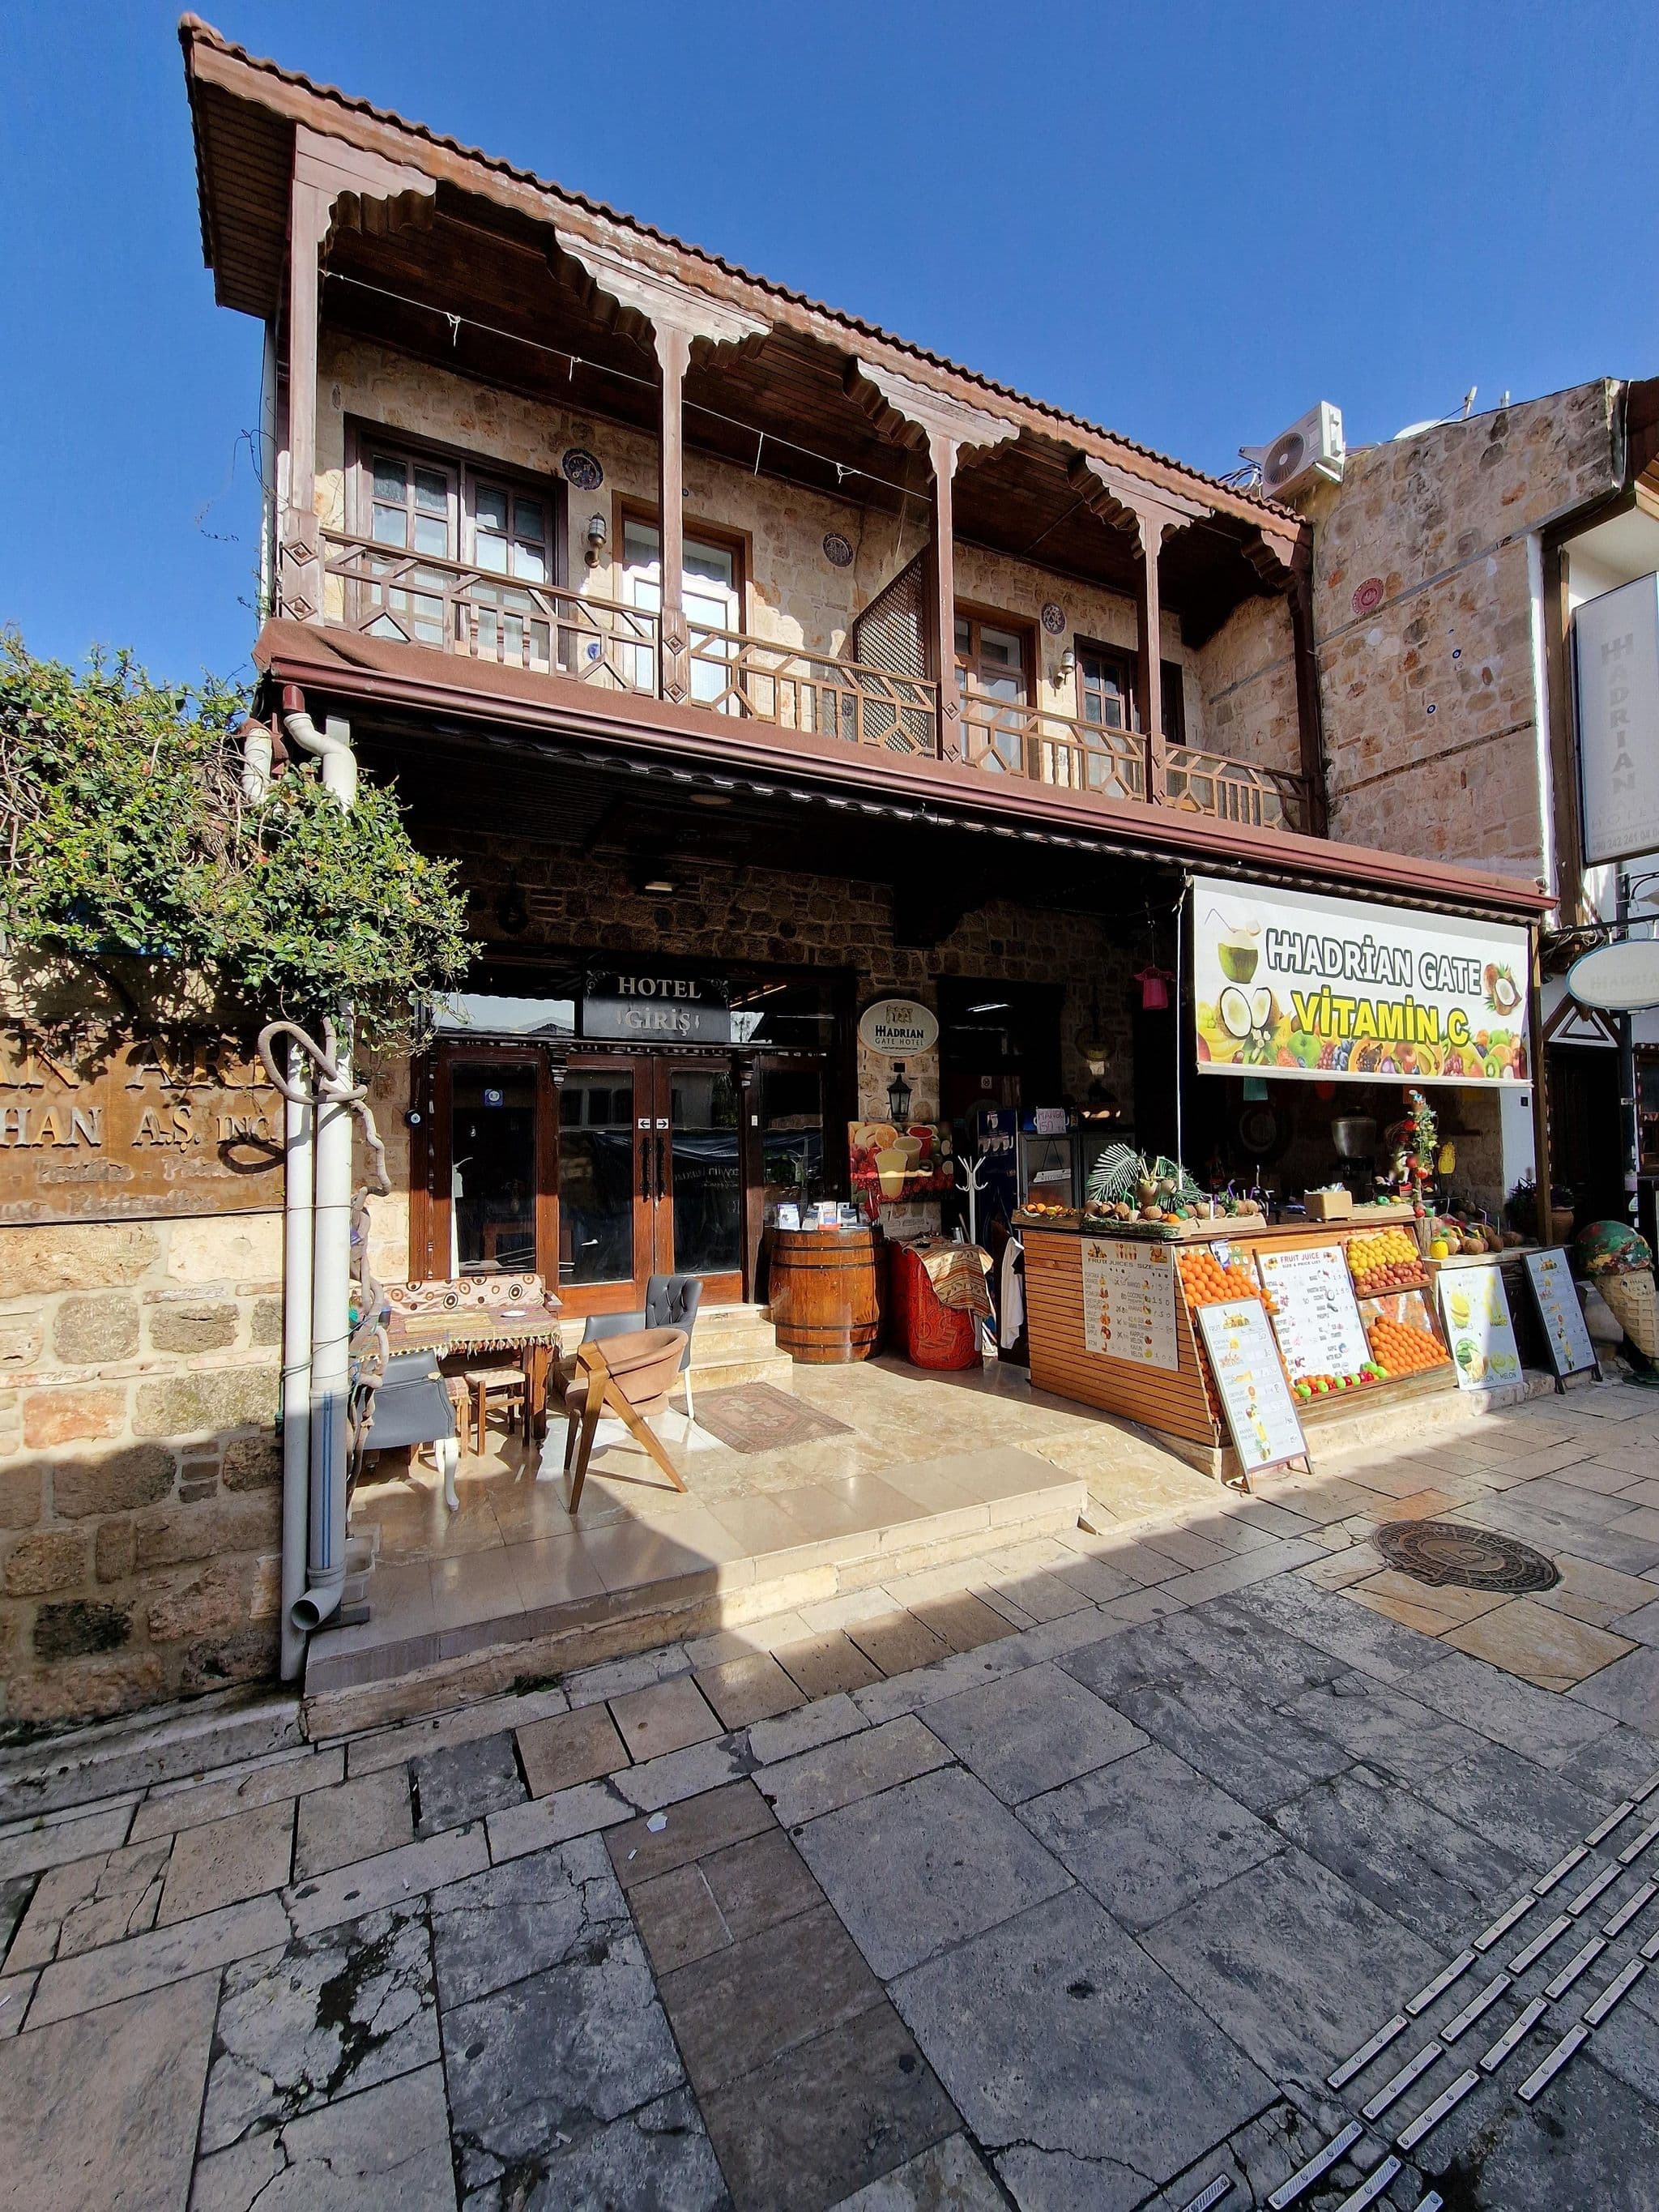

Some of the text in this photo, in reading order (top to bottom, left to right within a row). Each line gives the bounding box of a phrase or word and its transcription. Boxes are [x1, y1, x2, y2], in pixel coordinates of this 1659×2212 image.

[618, 976, 702, 999] HOTEL
[1418, 951, 1482, 996] GATE
[1290, 984, 1469, 1047] VİTAMİN C
[1280, 1252, 1320, 1263] FRUIT JUICE
